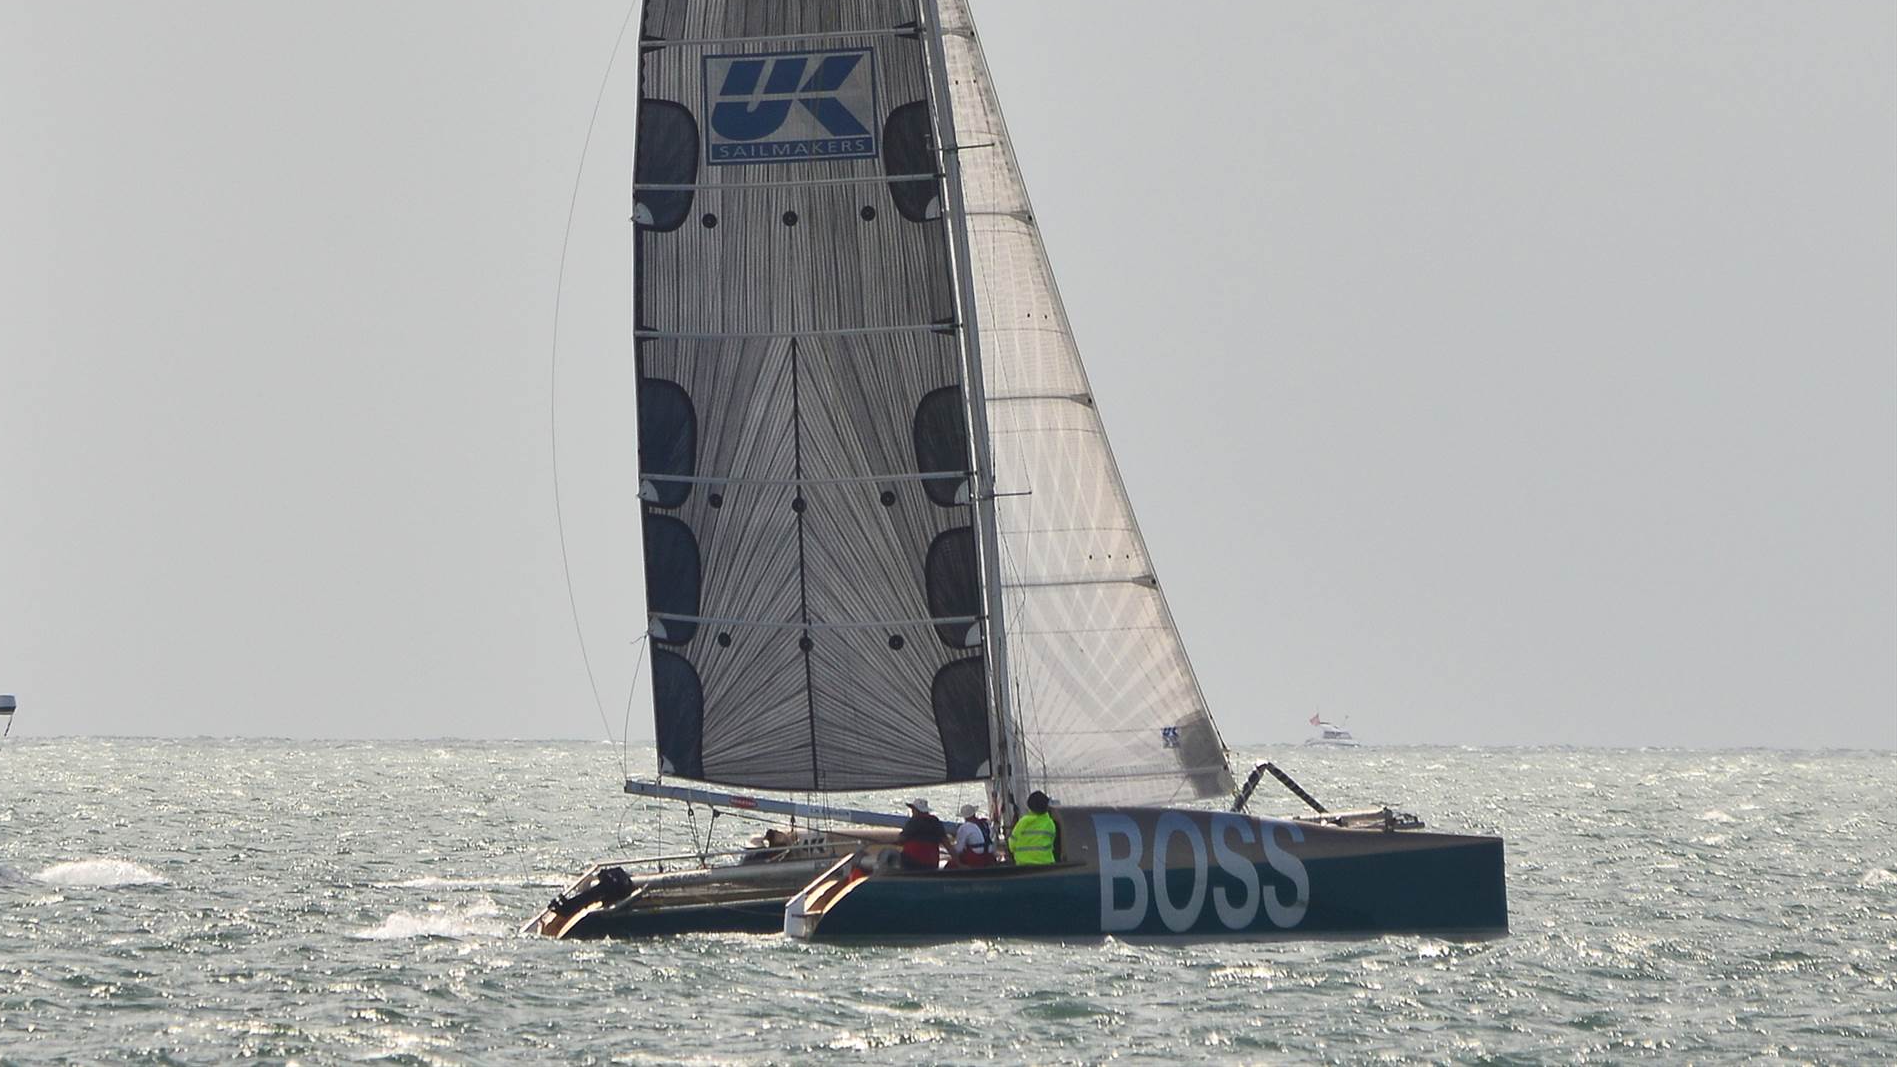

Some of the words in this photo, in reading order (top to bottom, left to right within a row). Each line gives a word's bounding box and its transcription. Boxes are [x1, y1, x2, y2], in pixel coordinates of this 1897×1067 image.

[711, 54, 870, 141] UK
[719, 139, 865, 158] SAILMAKERS
[1091, 811, 1310, 932] BOSS
